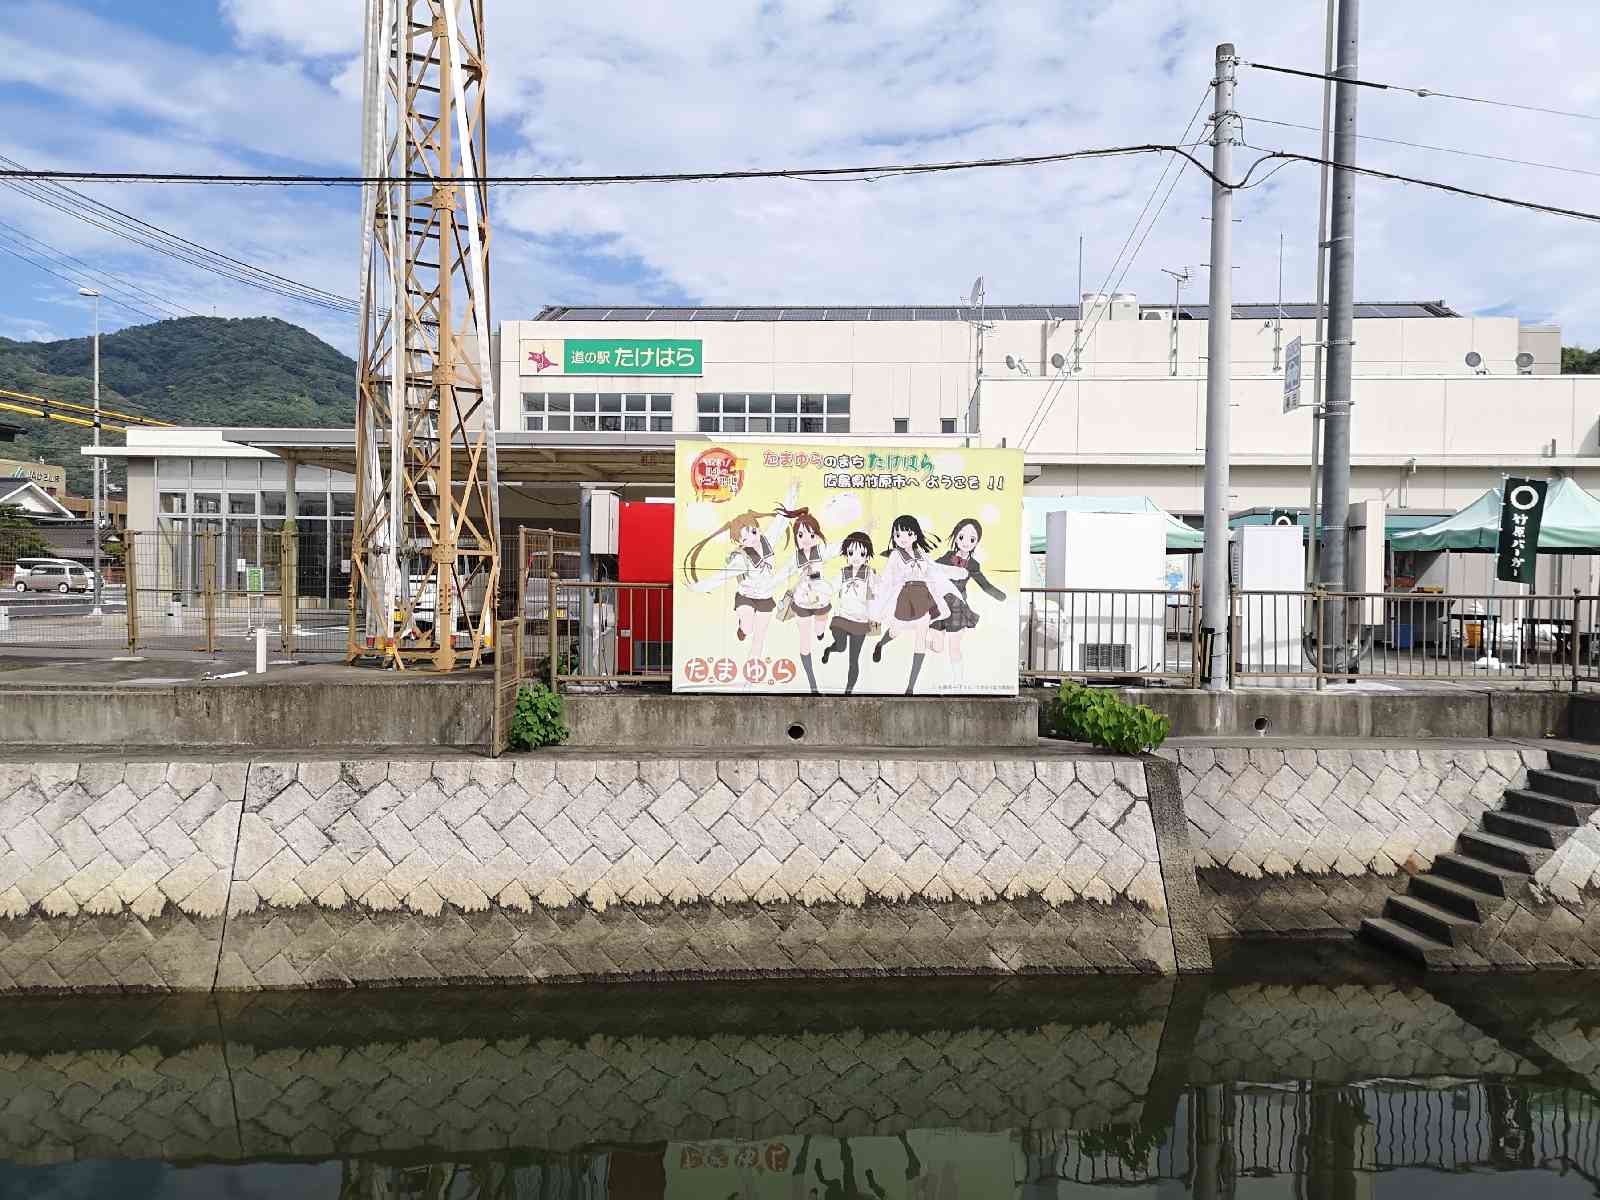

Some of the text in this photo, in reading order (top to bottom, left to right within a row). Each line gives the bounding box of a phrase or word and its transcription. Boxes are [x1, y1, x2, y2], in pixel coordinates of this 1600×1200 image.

[571, 347, 695, 368] 道の駅 たけはら
[763, 452, 935, 473] たまゆらのまち たけはら
[823, 473, 919, 489] 広島県竹原市へ
[927, 475, 981, 490] ようこそ
[1511, 513, 1529, 577] 竹原バーガー
[685, 656, 797, 684] たまゆら
